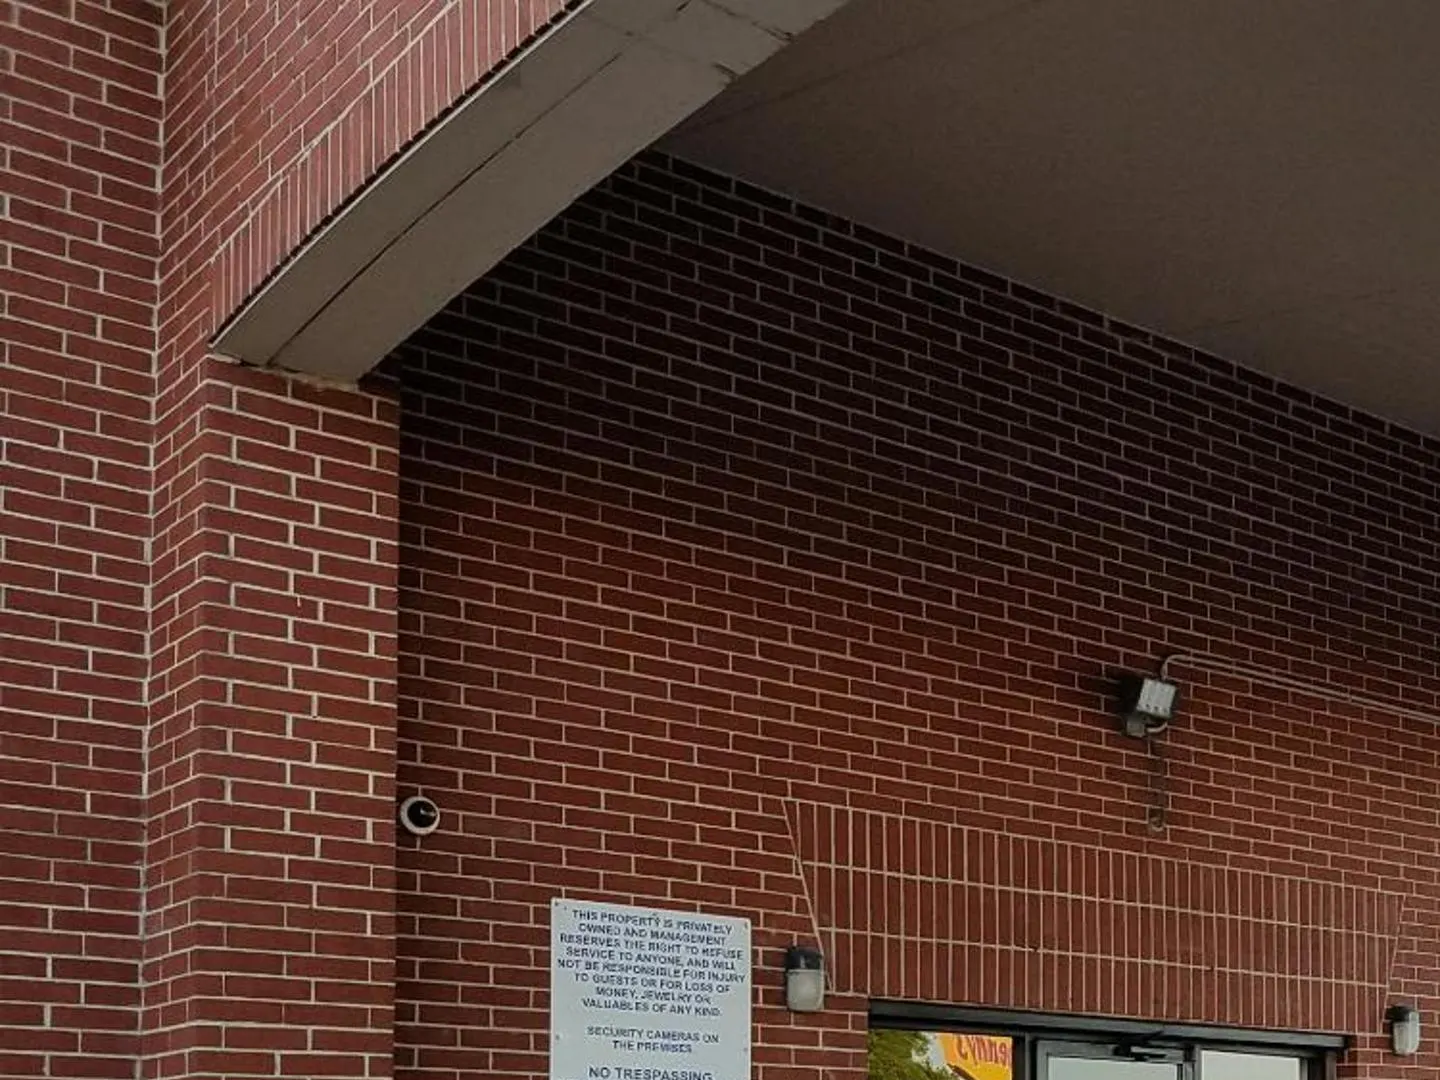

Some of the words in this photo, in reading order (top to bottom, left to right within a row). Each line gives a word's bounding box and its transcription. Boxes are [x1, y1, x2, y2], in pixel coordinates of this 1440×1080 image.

[572, 909, 598, 920] THIS
[601, 912, 659, 927] PROPERTY
[663, 918, 673, 927] IS
[677, 920, 732, 934] PRIVATELY
[579, 923, 620, 935] OWNED
[624, 927, 647, 937] AND
[650, 929, 726, 946] MANAGEMENT
[560, 934, 620, 948] RESERVES
[625, 940, 645, 950] THE
[649, 941, 681, 954] RIGHT
[686, 946, 698, 954] TO
[702, 947, 744, 960] REFUSE
[566, 946, 615, 960] SERVICE
[620, 952, 632, 960] TO
[687, 958, 709, 968] AND
[712, 961, 735, 970] WILL
[558, 959, 581, 968] NOT
[585, 961, 599, 970] BE
[602, 963, 679, 977] RESPONSIBLE
[684, 969, 704, 979] FOR
[708, 971, 745, 984] INJURY
[576, 972, 588, 982] TO
[593, 975, 638, 986] GUESTS
[641, 978, 657, 987] OR
[660, 979, 682, 990] FOR
[685, 981, 713, 992] LOSS
[716, 984, 730, 993] OF
[581, 998, 649, 1012] VALUABLES
[652, 1004, 666, 1013] OF
[670, 1005, 692, 1015] ANY
[695, 995, 712, 1005] OR
[587, 1026, 643, 1038] SECURITY
[647, 1031, 700, 1043] CAMERAS
[703, 1034, 719, 1043] ON
[613, 1041, 634, 1050] THE
[589, 1067, 611, 1078] NO
